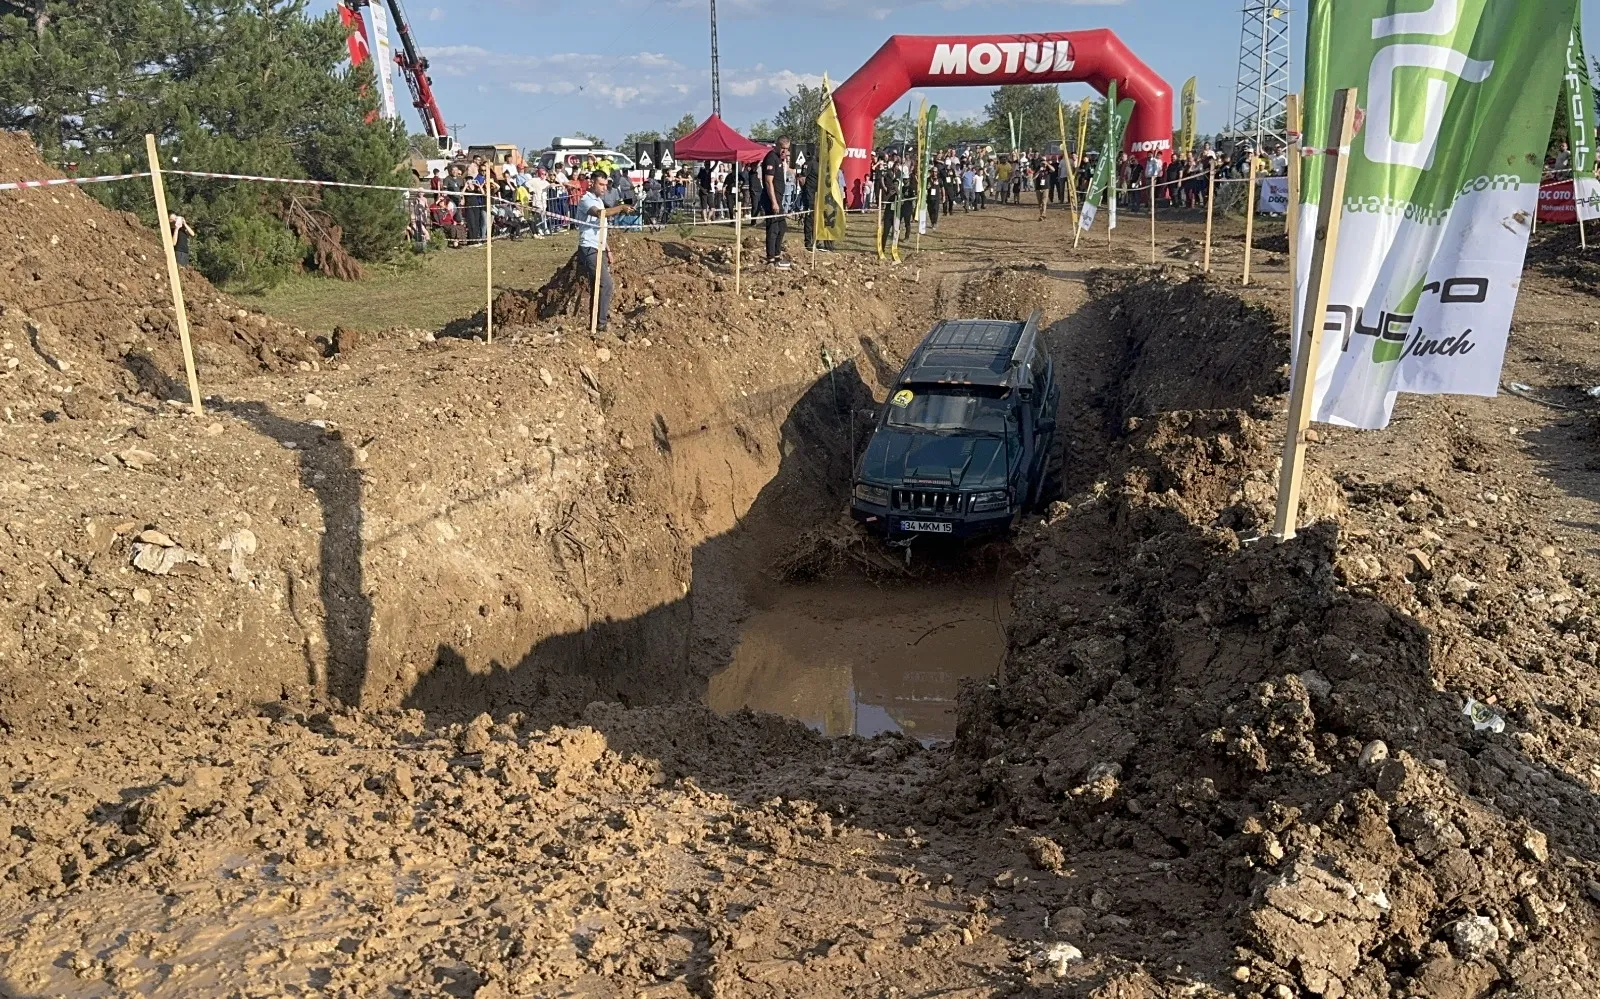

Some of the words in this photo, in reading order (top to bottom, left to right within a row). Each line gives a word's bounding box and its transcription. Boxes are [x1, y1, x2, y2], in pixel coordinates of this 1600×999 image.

[929, 40, 1075, 75] MOTUL
[1131, 139, 1171, 152] MOTUL
[1553, 190, 1571, 200] OTO
[905, 521, 916, 530] 34
[918, 522, 939, 532] MKM
[942, 523, 952, 532] 15
